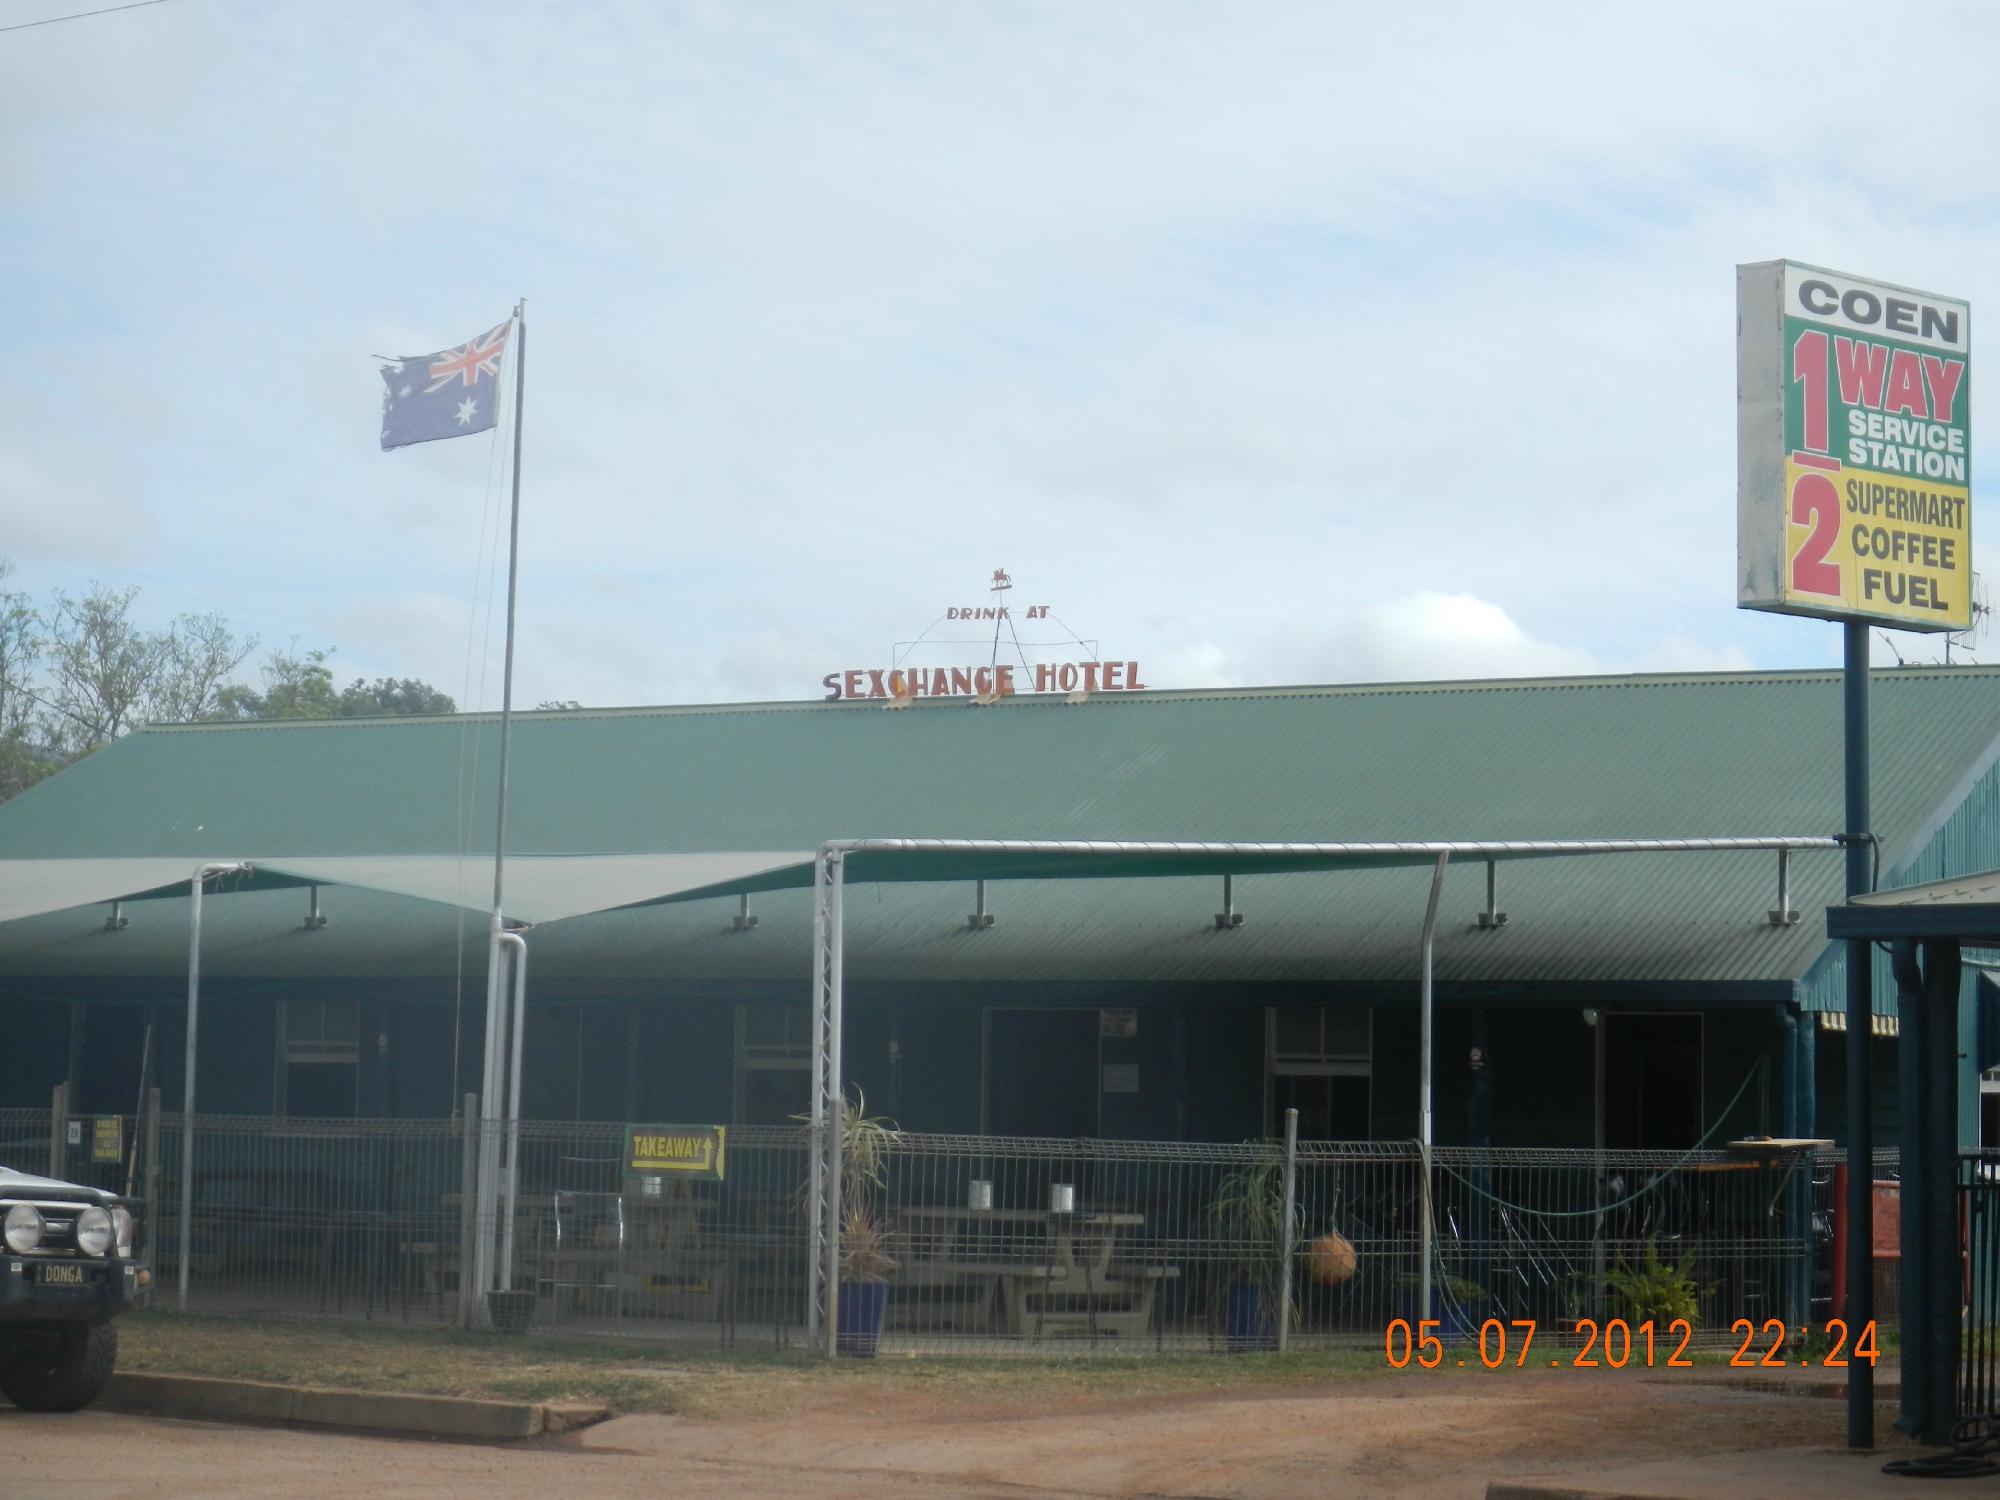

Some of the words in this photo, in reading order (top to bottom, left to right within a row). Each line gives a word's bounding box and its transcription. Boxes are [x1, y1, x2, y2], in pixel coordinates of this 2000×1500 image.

[1799, 279, 1958, 344] COEN
[1793, 329, 1829, 453] 1
[1834, 335, 1965, 423] WAY
[1848, 409, 1964, 453] SERVICE
[1848, 440, 1965, 481] STATION
[1846, 479, 1965, 530] SUPERMART
[1791, 472, 1841, 597] 2
[1851, 524, 1956, 570] COFFEE
[1863, 568, 1949, 611] FUEL
[947, 606, 1009, 620] DRINK
[1026, 605, 1050, 619] AT
[1036, 661, 1147, 692] HOTEL
[633, 1135, 701, 1158] TAKEAWAY
[45, 1266, 83, 1284] DONGA
